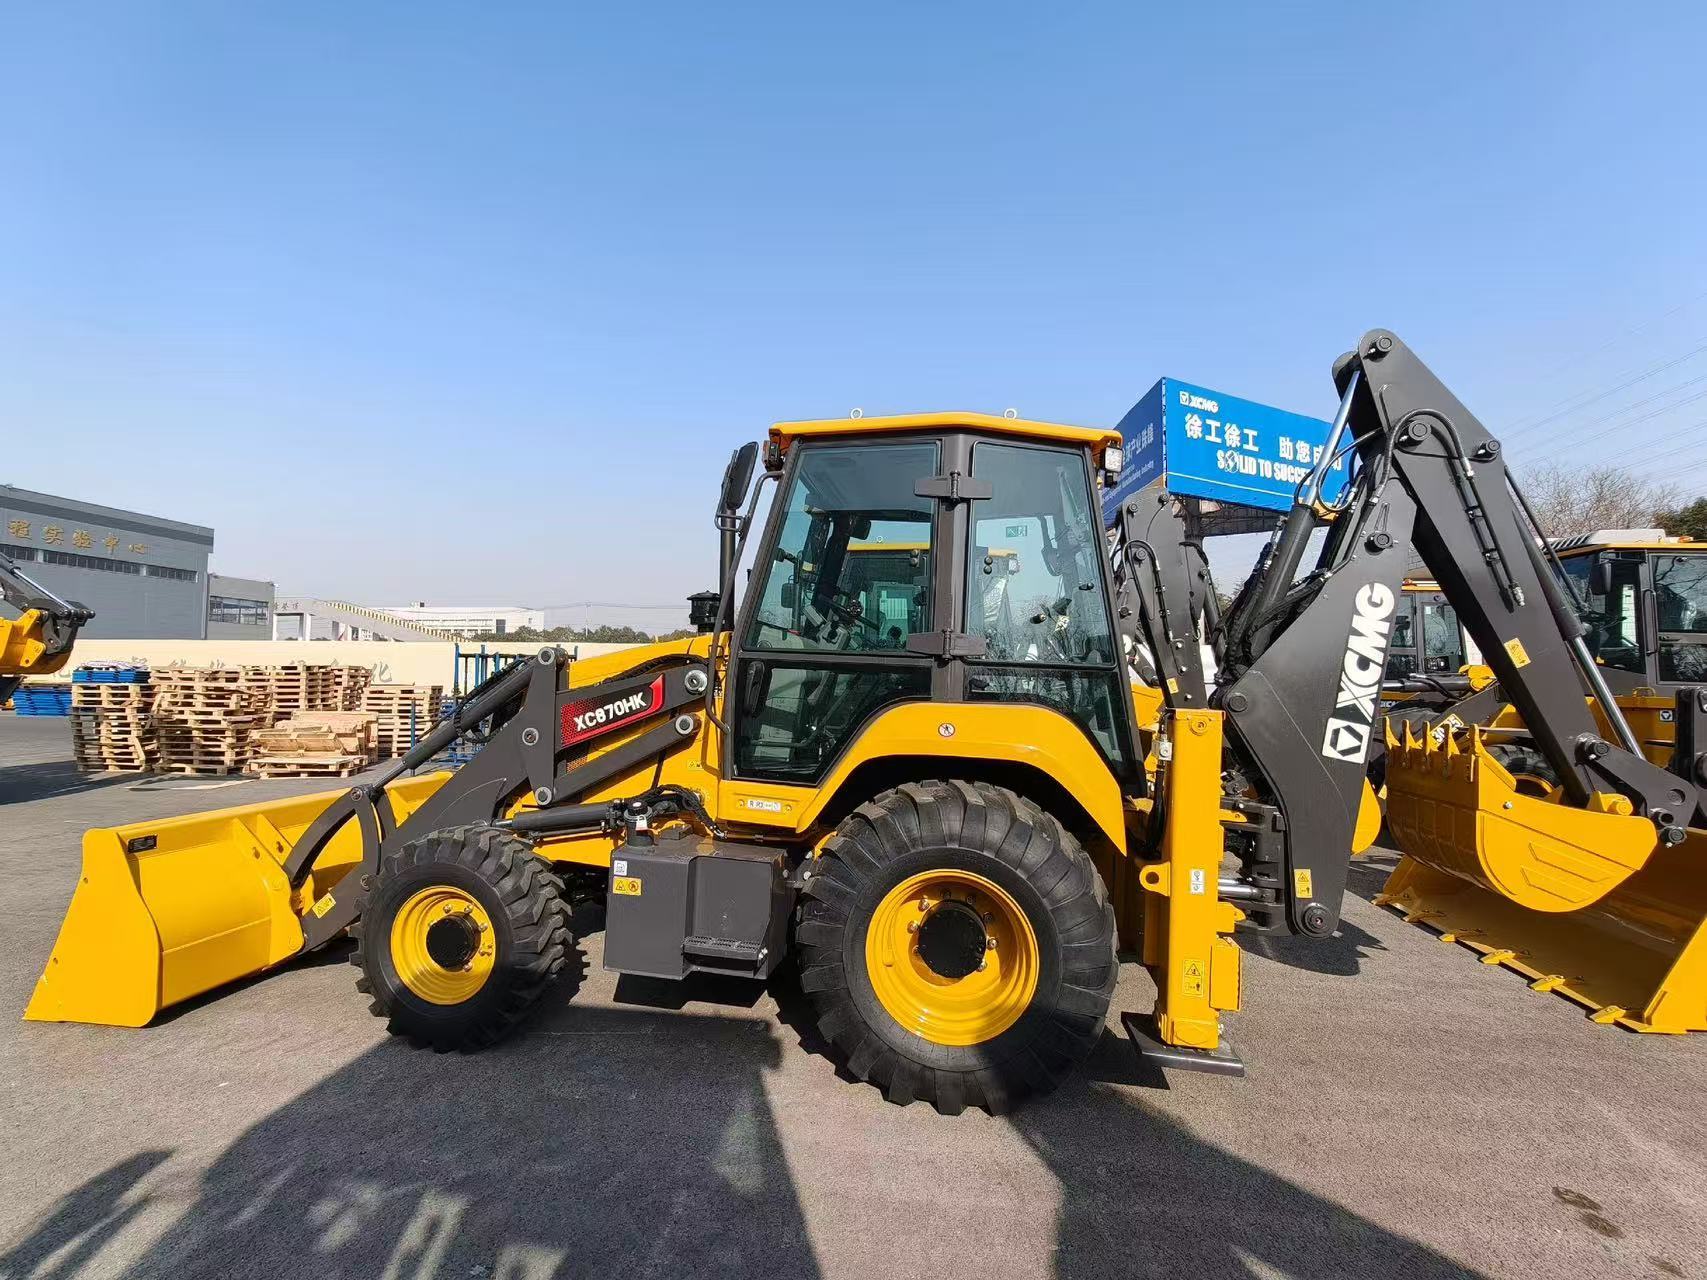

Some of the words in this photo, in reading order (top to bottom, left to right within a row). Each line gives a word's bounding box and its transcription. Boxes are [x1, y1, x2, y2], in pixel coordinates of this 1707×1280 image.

[1189, 396, 1219, 413] XCMG
[1185, 413, 1259, 452] 徐工徐工
[1217, 449, 1257, 476] SOLID
[1256, 456, 1272, 479] TO
[1273, 462, 1312, 486] SUCCE
[1336, 582, 1395, 723] XCMG
[573, 692, 647, 731] XC870HK
